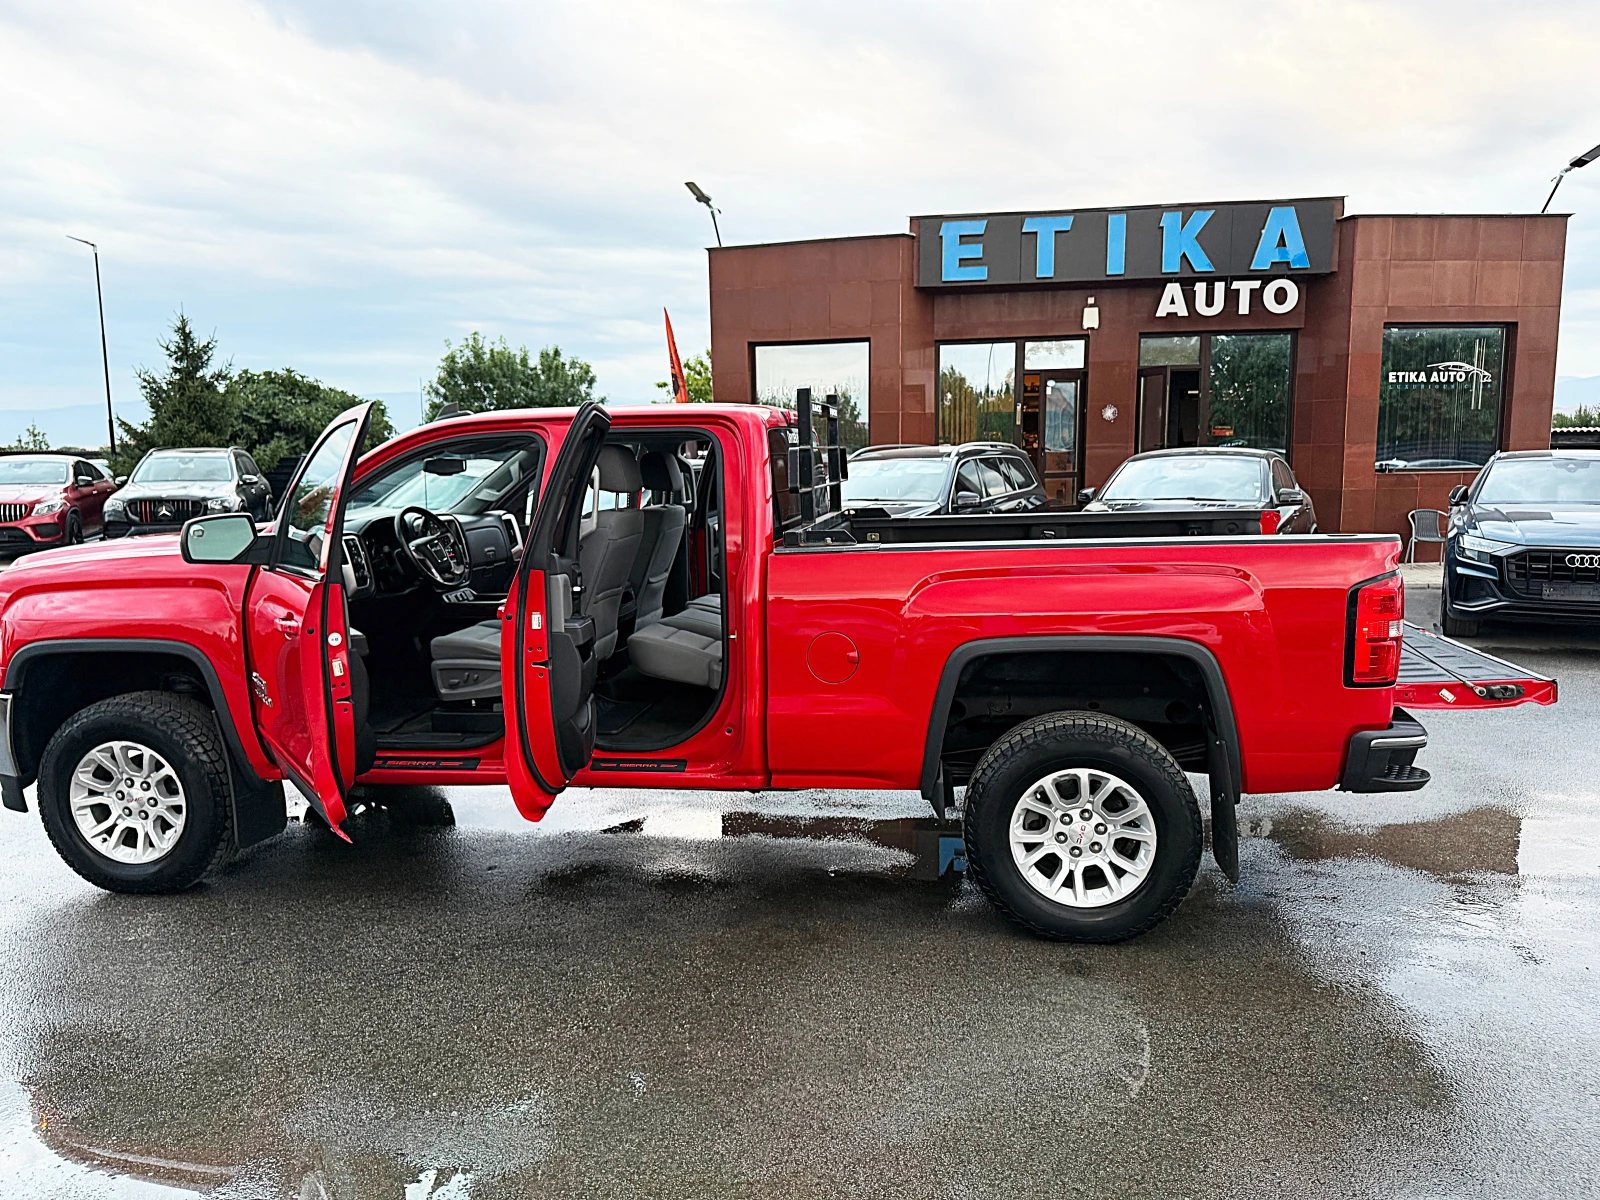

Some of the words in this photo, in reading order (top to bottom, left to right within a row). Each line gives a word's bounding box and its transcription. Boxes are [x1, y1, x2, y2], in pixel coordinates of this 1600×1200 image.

[939, 206, 1310, 282] ETIKA
[1155, 278, 1299, 317] AUTO
[1388, 371, 1427, 383] ETIKA
[1430, 371, 1466, 383] AUTO
[1076, 824, 1087, 845] GMC
